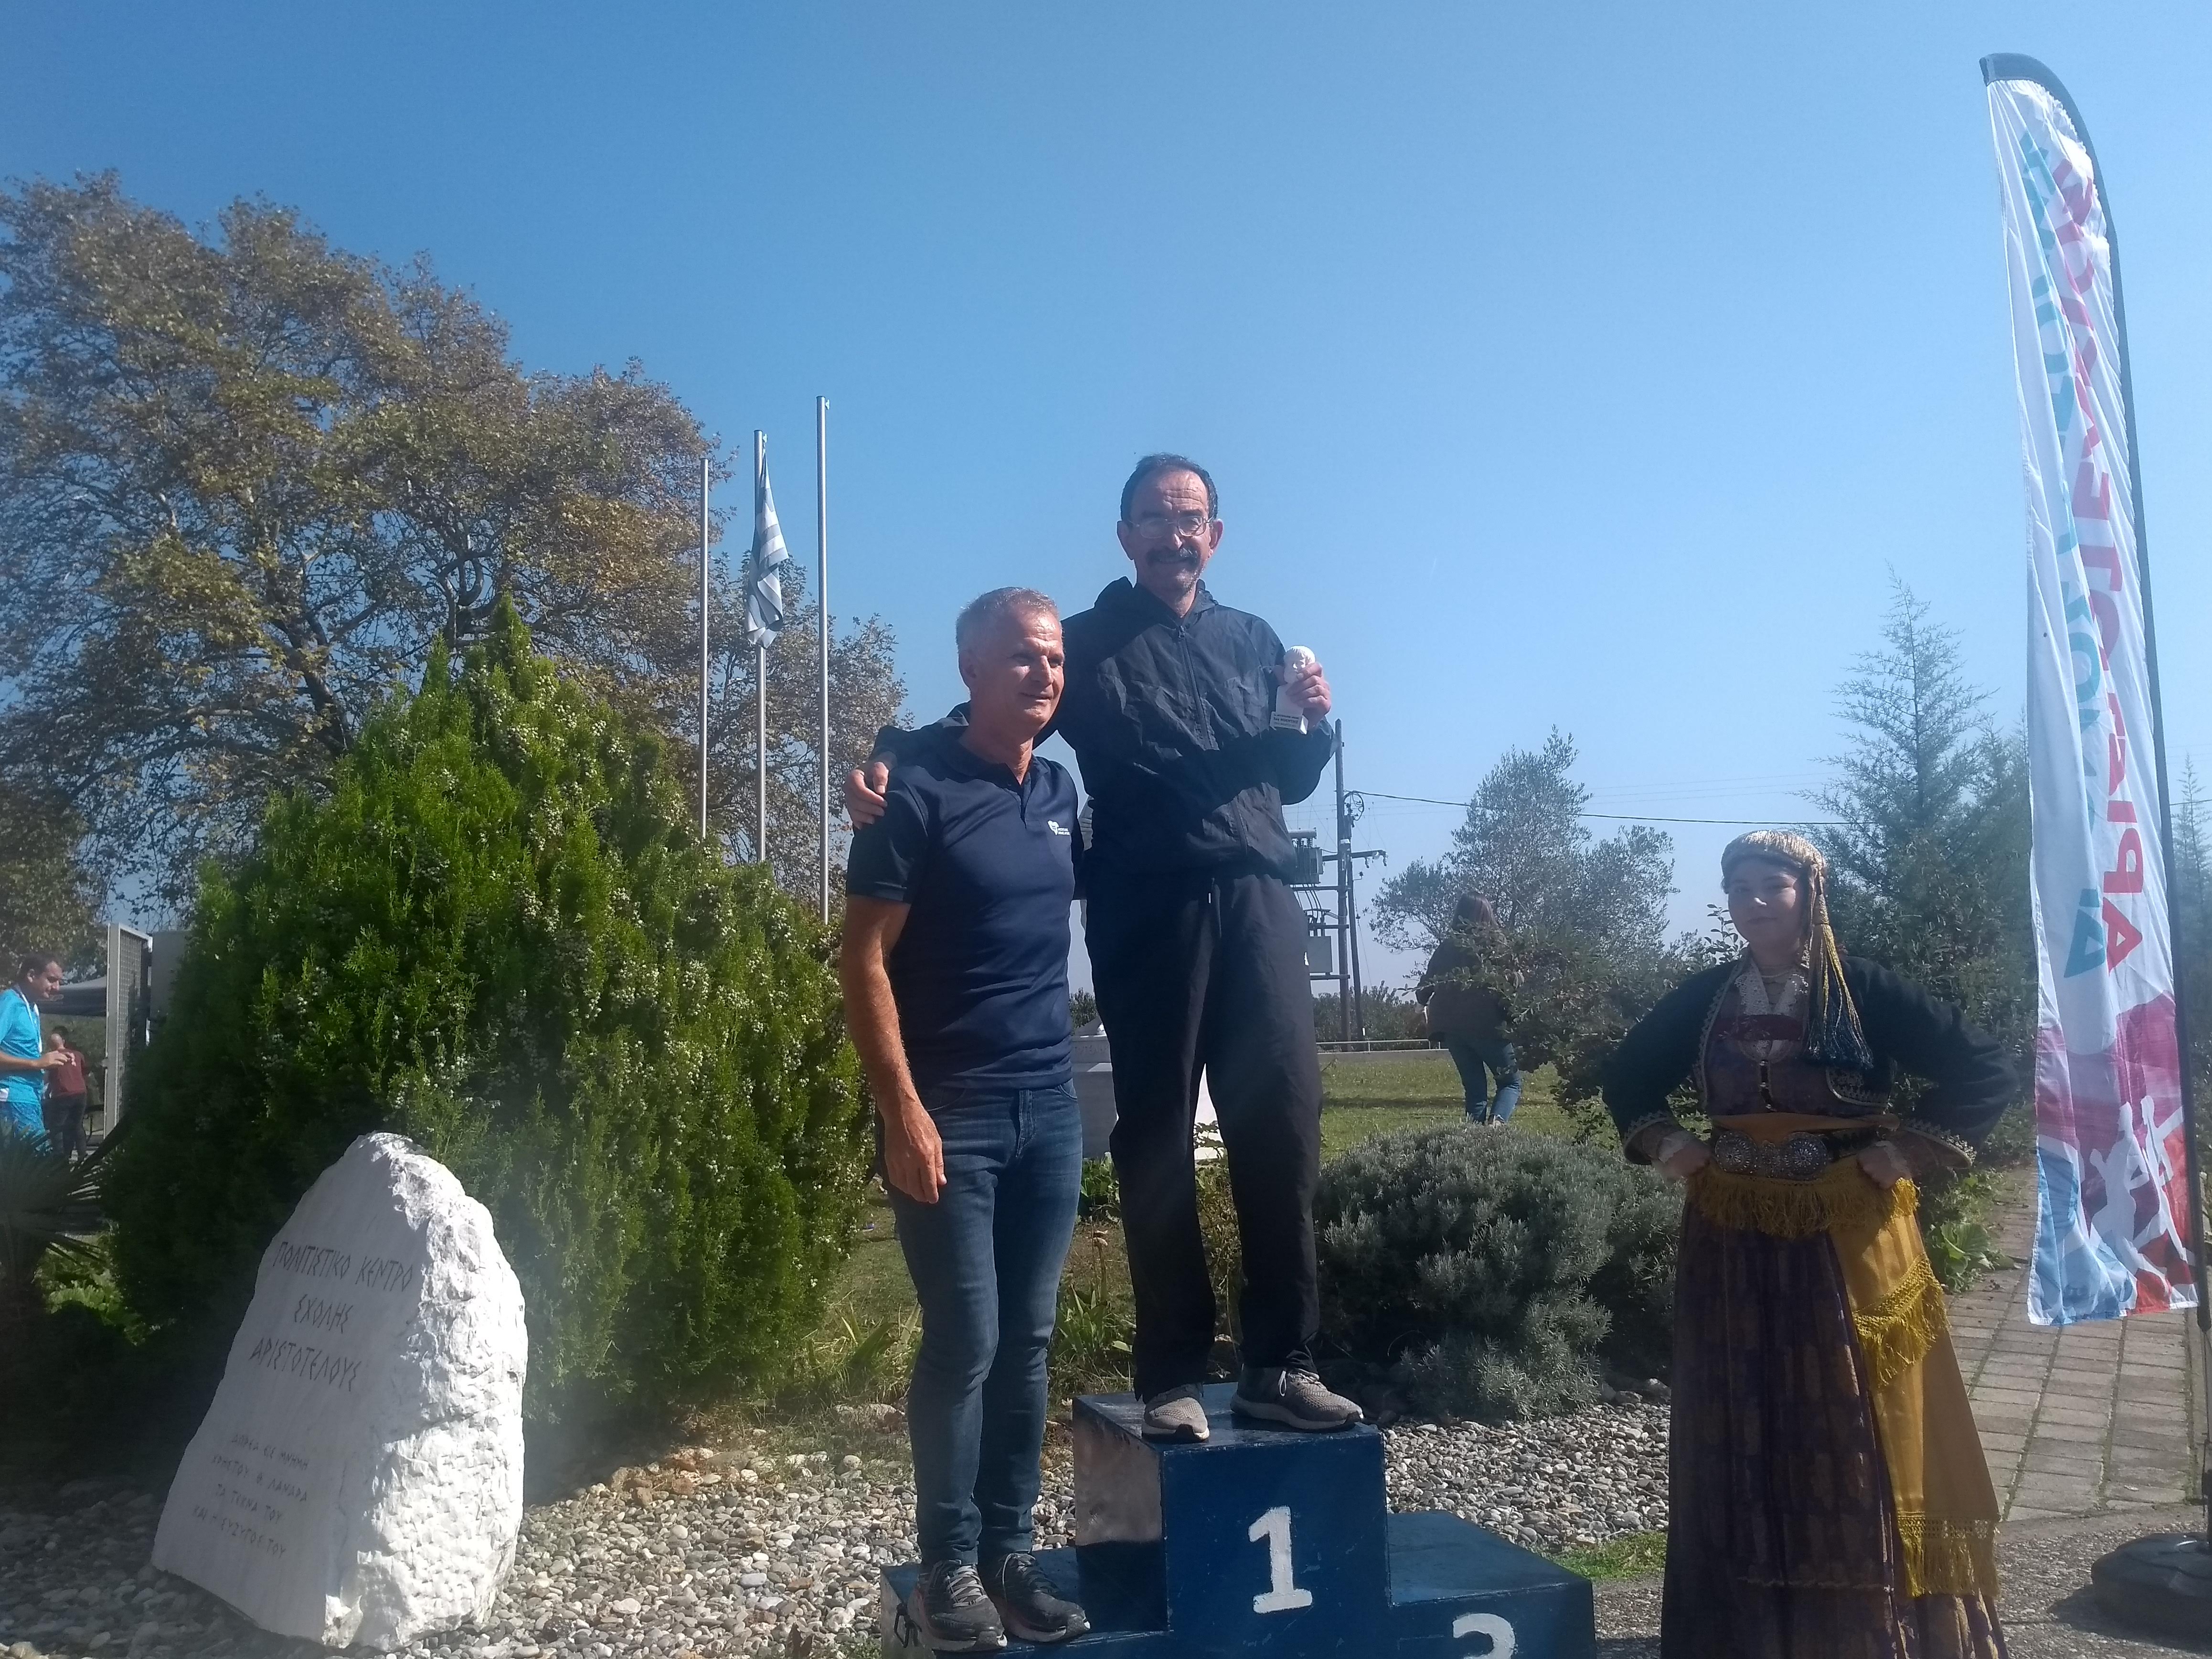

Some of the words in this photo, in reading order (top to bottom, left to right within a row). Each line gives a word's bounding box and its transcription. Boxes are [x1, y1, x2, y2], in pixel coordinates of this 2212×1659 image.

[273, 1242, 351, 1280] ΠΟΛΙΤΙΣΤΙΚΟ
[355, 1256, 413, 1292] ΚΕΝΤΡΟ
[295, 1294, 353, 1334] ΣΧΟΛΗΣ
[248, 1338, 362, 1392] ΑΡΙΣΤΟΤΕΛΟΥΣ
[1248, 1505, 1313, 1614] 1
